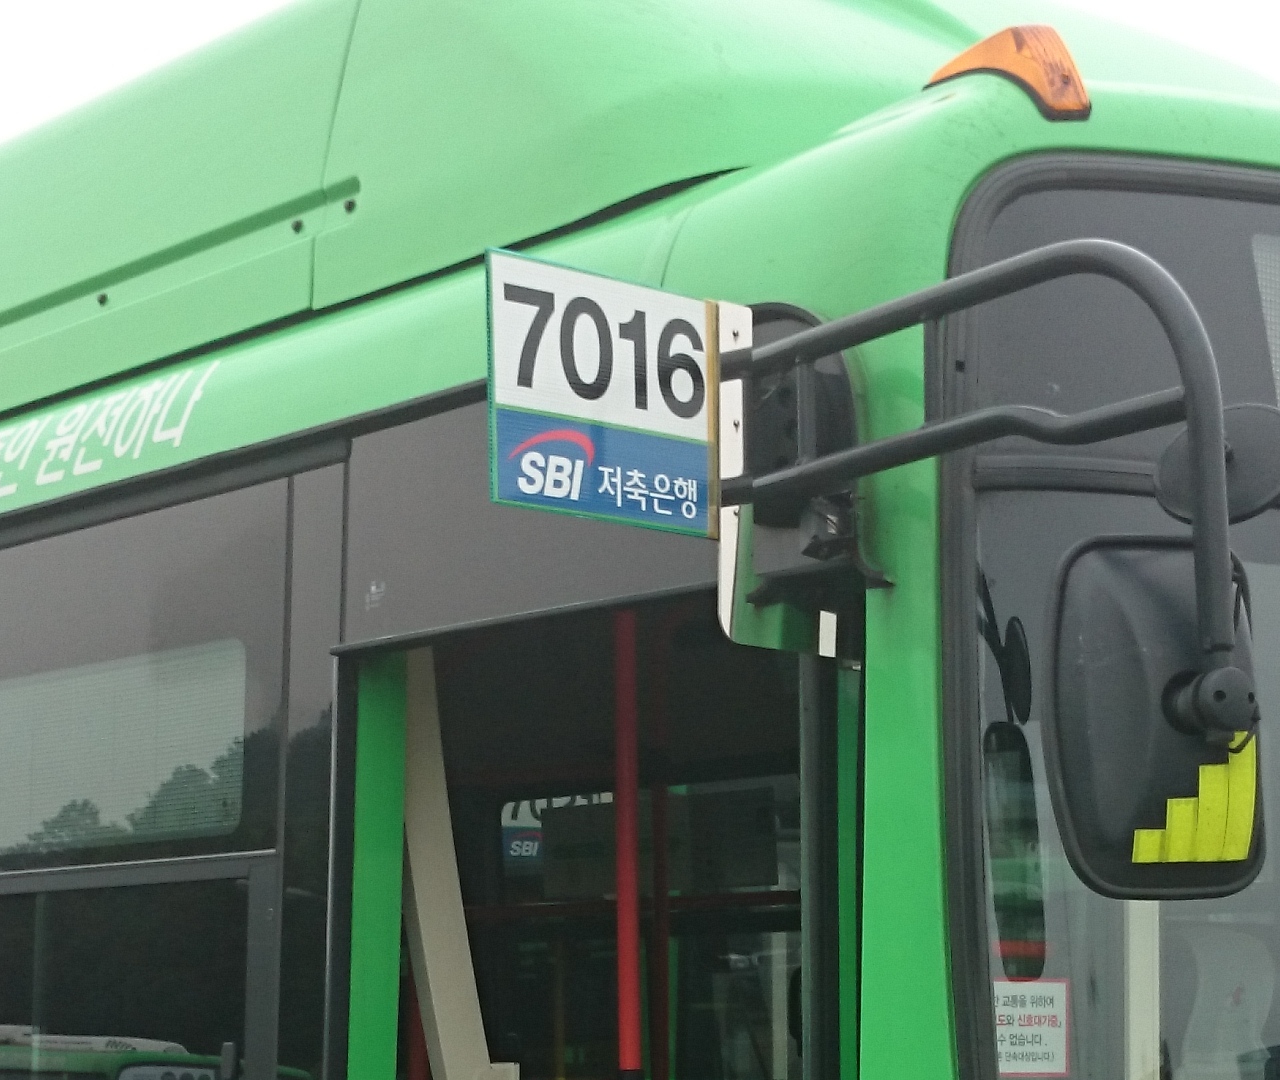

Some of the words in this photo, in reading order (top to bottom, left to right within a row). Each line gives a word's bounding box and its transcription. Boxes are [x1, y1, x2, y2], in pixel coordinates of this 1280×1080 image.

[503, 282, 706, 419] 7016
[517, 450, 586, 501] SBI
[597, 463, 699, 519] 저축은행
[509, 840, 540, 857] SBI
[1030, 994, 1055, 1009] 위하여
